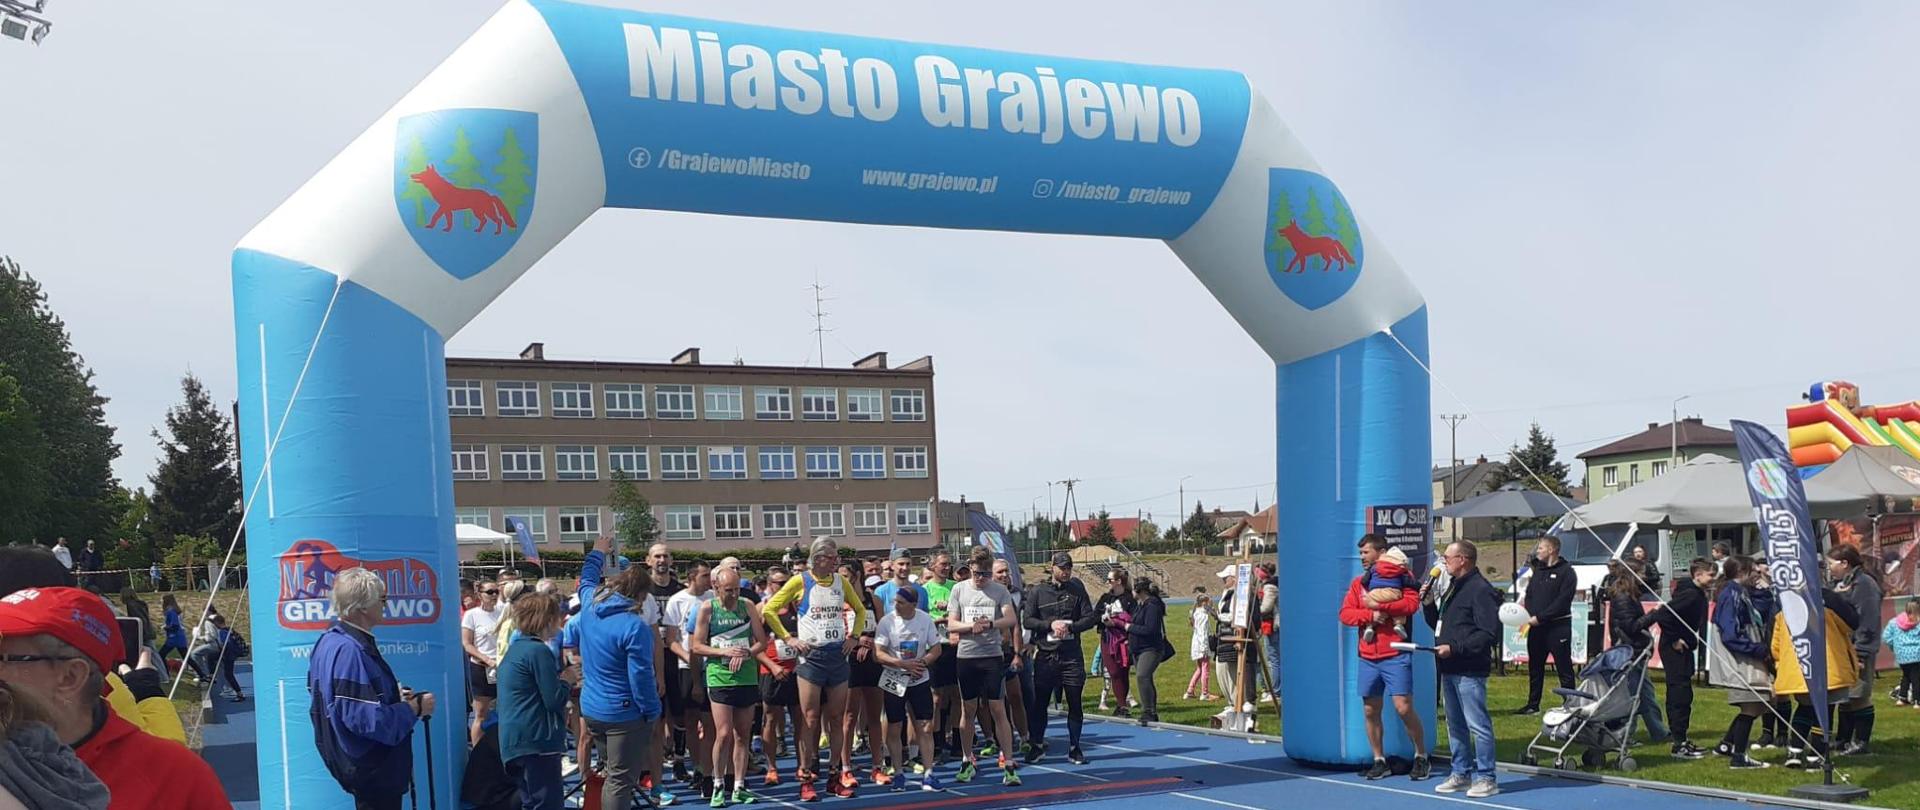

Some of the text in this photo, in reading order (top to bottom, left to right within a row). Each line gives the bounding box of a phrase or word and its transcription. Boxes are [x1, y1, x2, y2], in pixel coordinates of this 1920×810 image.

[621, 22, 1202, 147] Miasto Grajewo
[658, 149, 811, 180] /GrajewoMiasto
[862, 168, 998, 194] www.grajewo.pl
[1056, 180, 1191, 205] /miasto_grajewo
[284, 600, 434, 621] GRAWO
[824, 629, 839, 640] 80
[884, 678, 897, 691] 25
